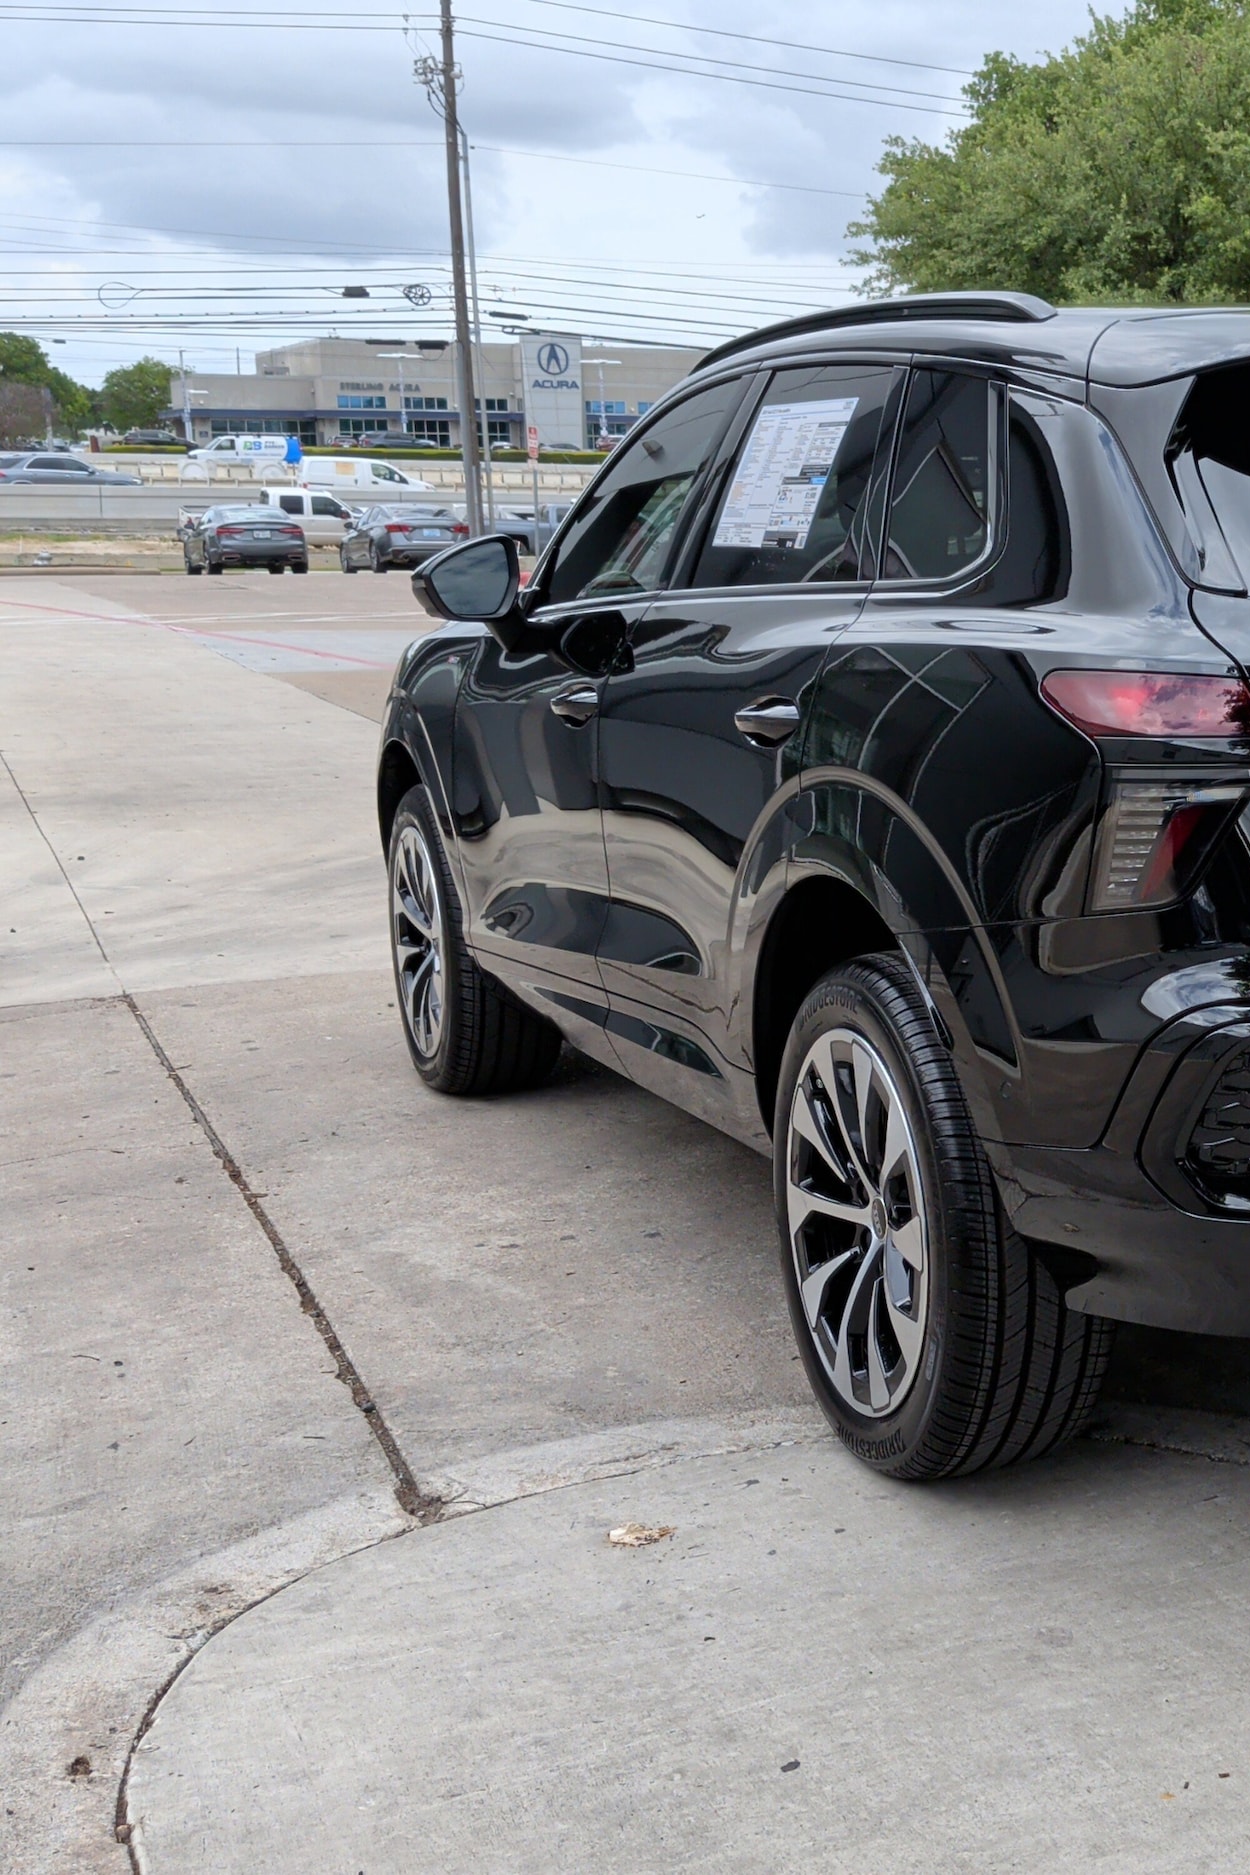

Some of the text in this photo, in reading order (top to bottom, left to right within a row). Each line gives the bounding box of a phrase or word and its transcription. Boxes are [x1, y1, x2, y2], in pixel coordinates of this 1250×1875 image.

[532, 379, 580, 390] ACURA
[796, 984, 862, 1032] BRIDGESTONE
[836, 1419, 907, 1461] BRIDGESTONE
